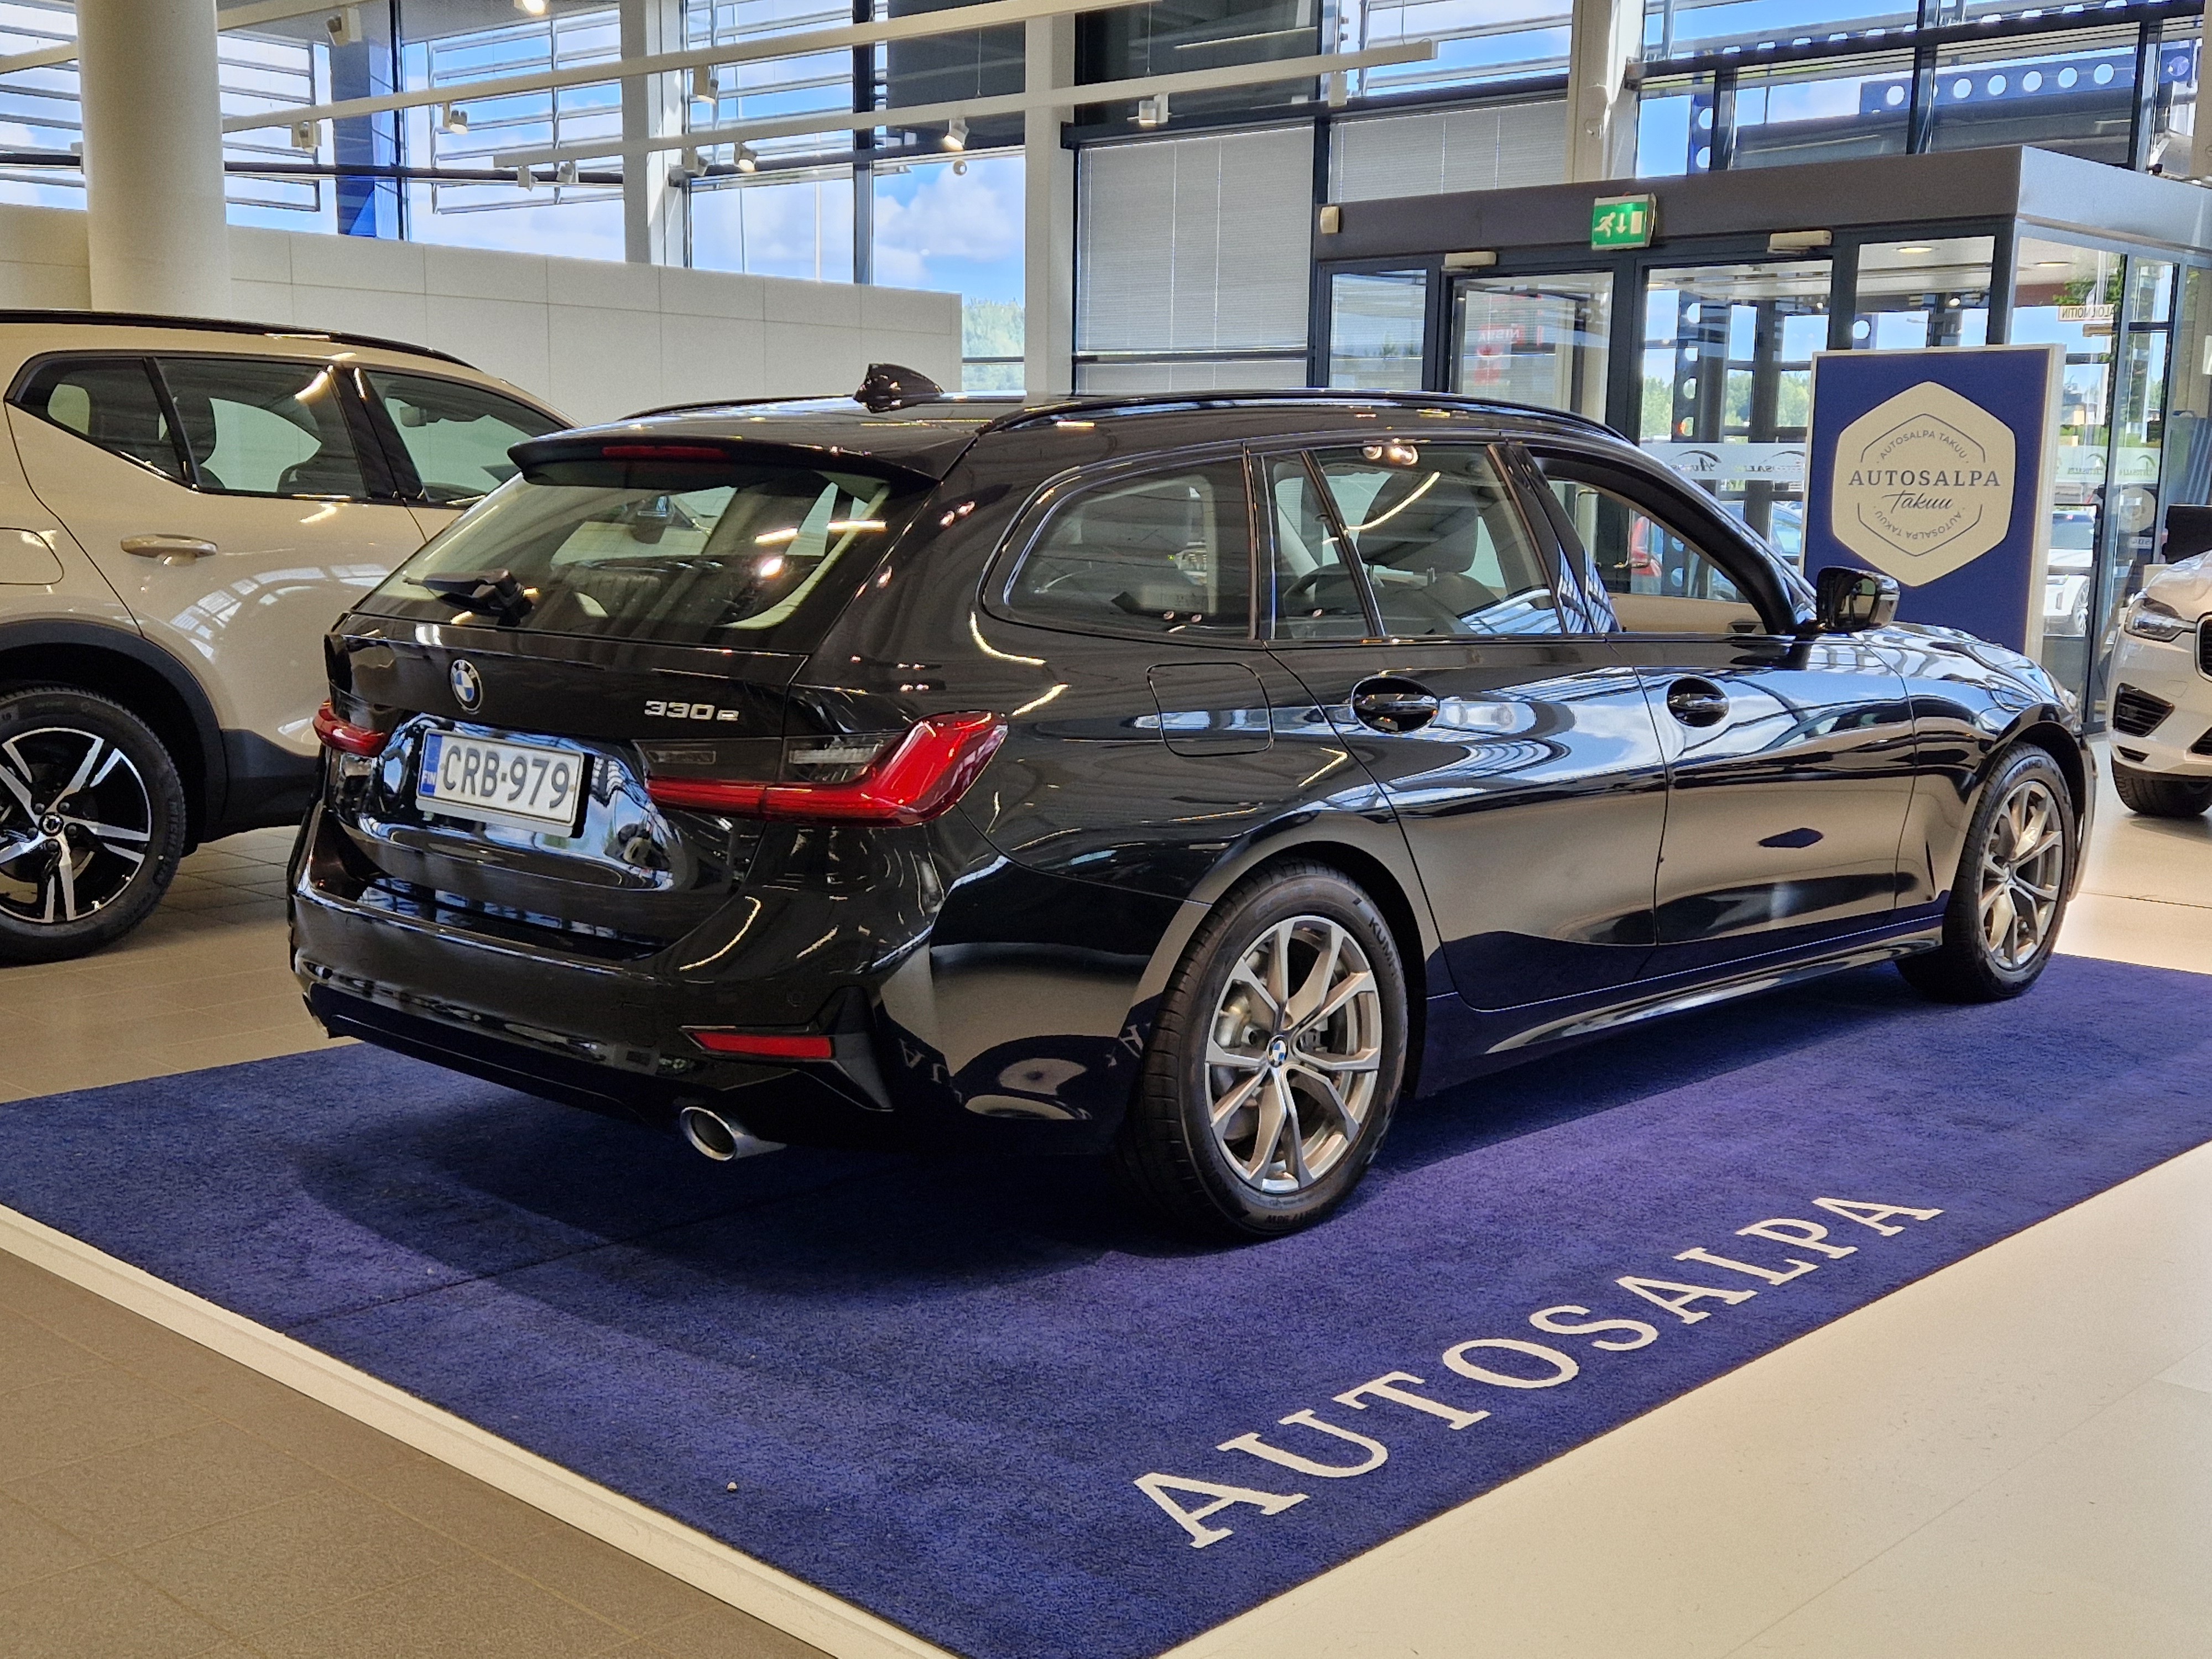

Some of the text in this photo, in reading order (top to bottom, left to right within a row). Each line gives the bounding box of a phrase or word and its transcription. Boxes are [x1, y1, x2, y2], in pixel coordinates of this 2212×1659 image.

[1880, 430, 1968, 460] AUTOSALPA TAKUU
[1848, 470, 2000, 487] AUTOSALPA
[1881, 489, 1953, 513] Takuu
[1875, 511, 1961, 540] AUTOSALPA TAKUU
[644, 700, 739, 722] 330e
[421, 770, 437, 785] FIN
[443, 745, 570, 808] CRB-979
[1132, 1196, 1944, 1549] AUTOSALPA
